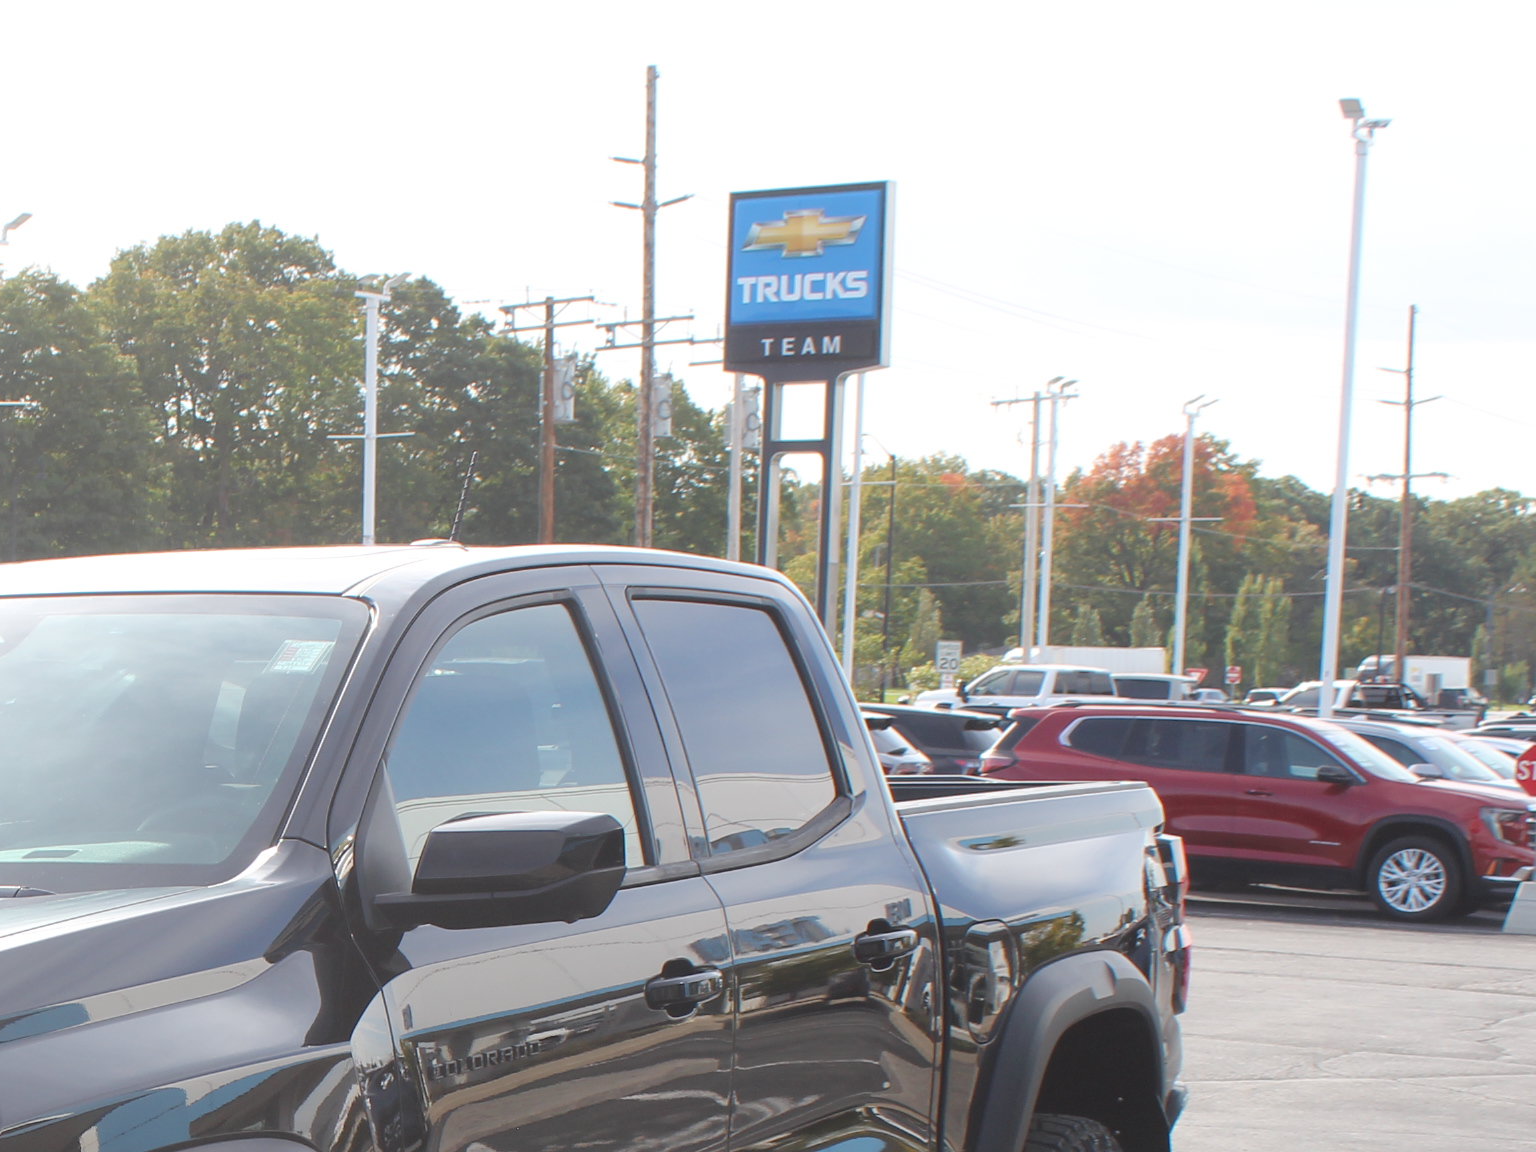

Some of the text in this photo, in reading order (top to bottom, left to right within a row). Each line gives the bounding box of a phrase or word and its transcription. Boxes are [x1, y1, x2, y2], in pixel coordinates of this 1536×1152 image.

[737, 270, 868, 304] TRUCKS
[761, 335, 841, 357] TEAM
[939, 657, 958, 670] 20
